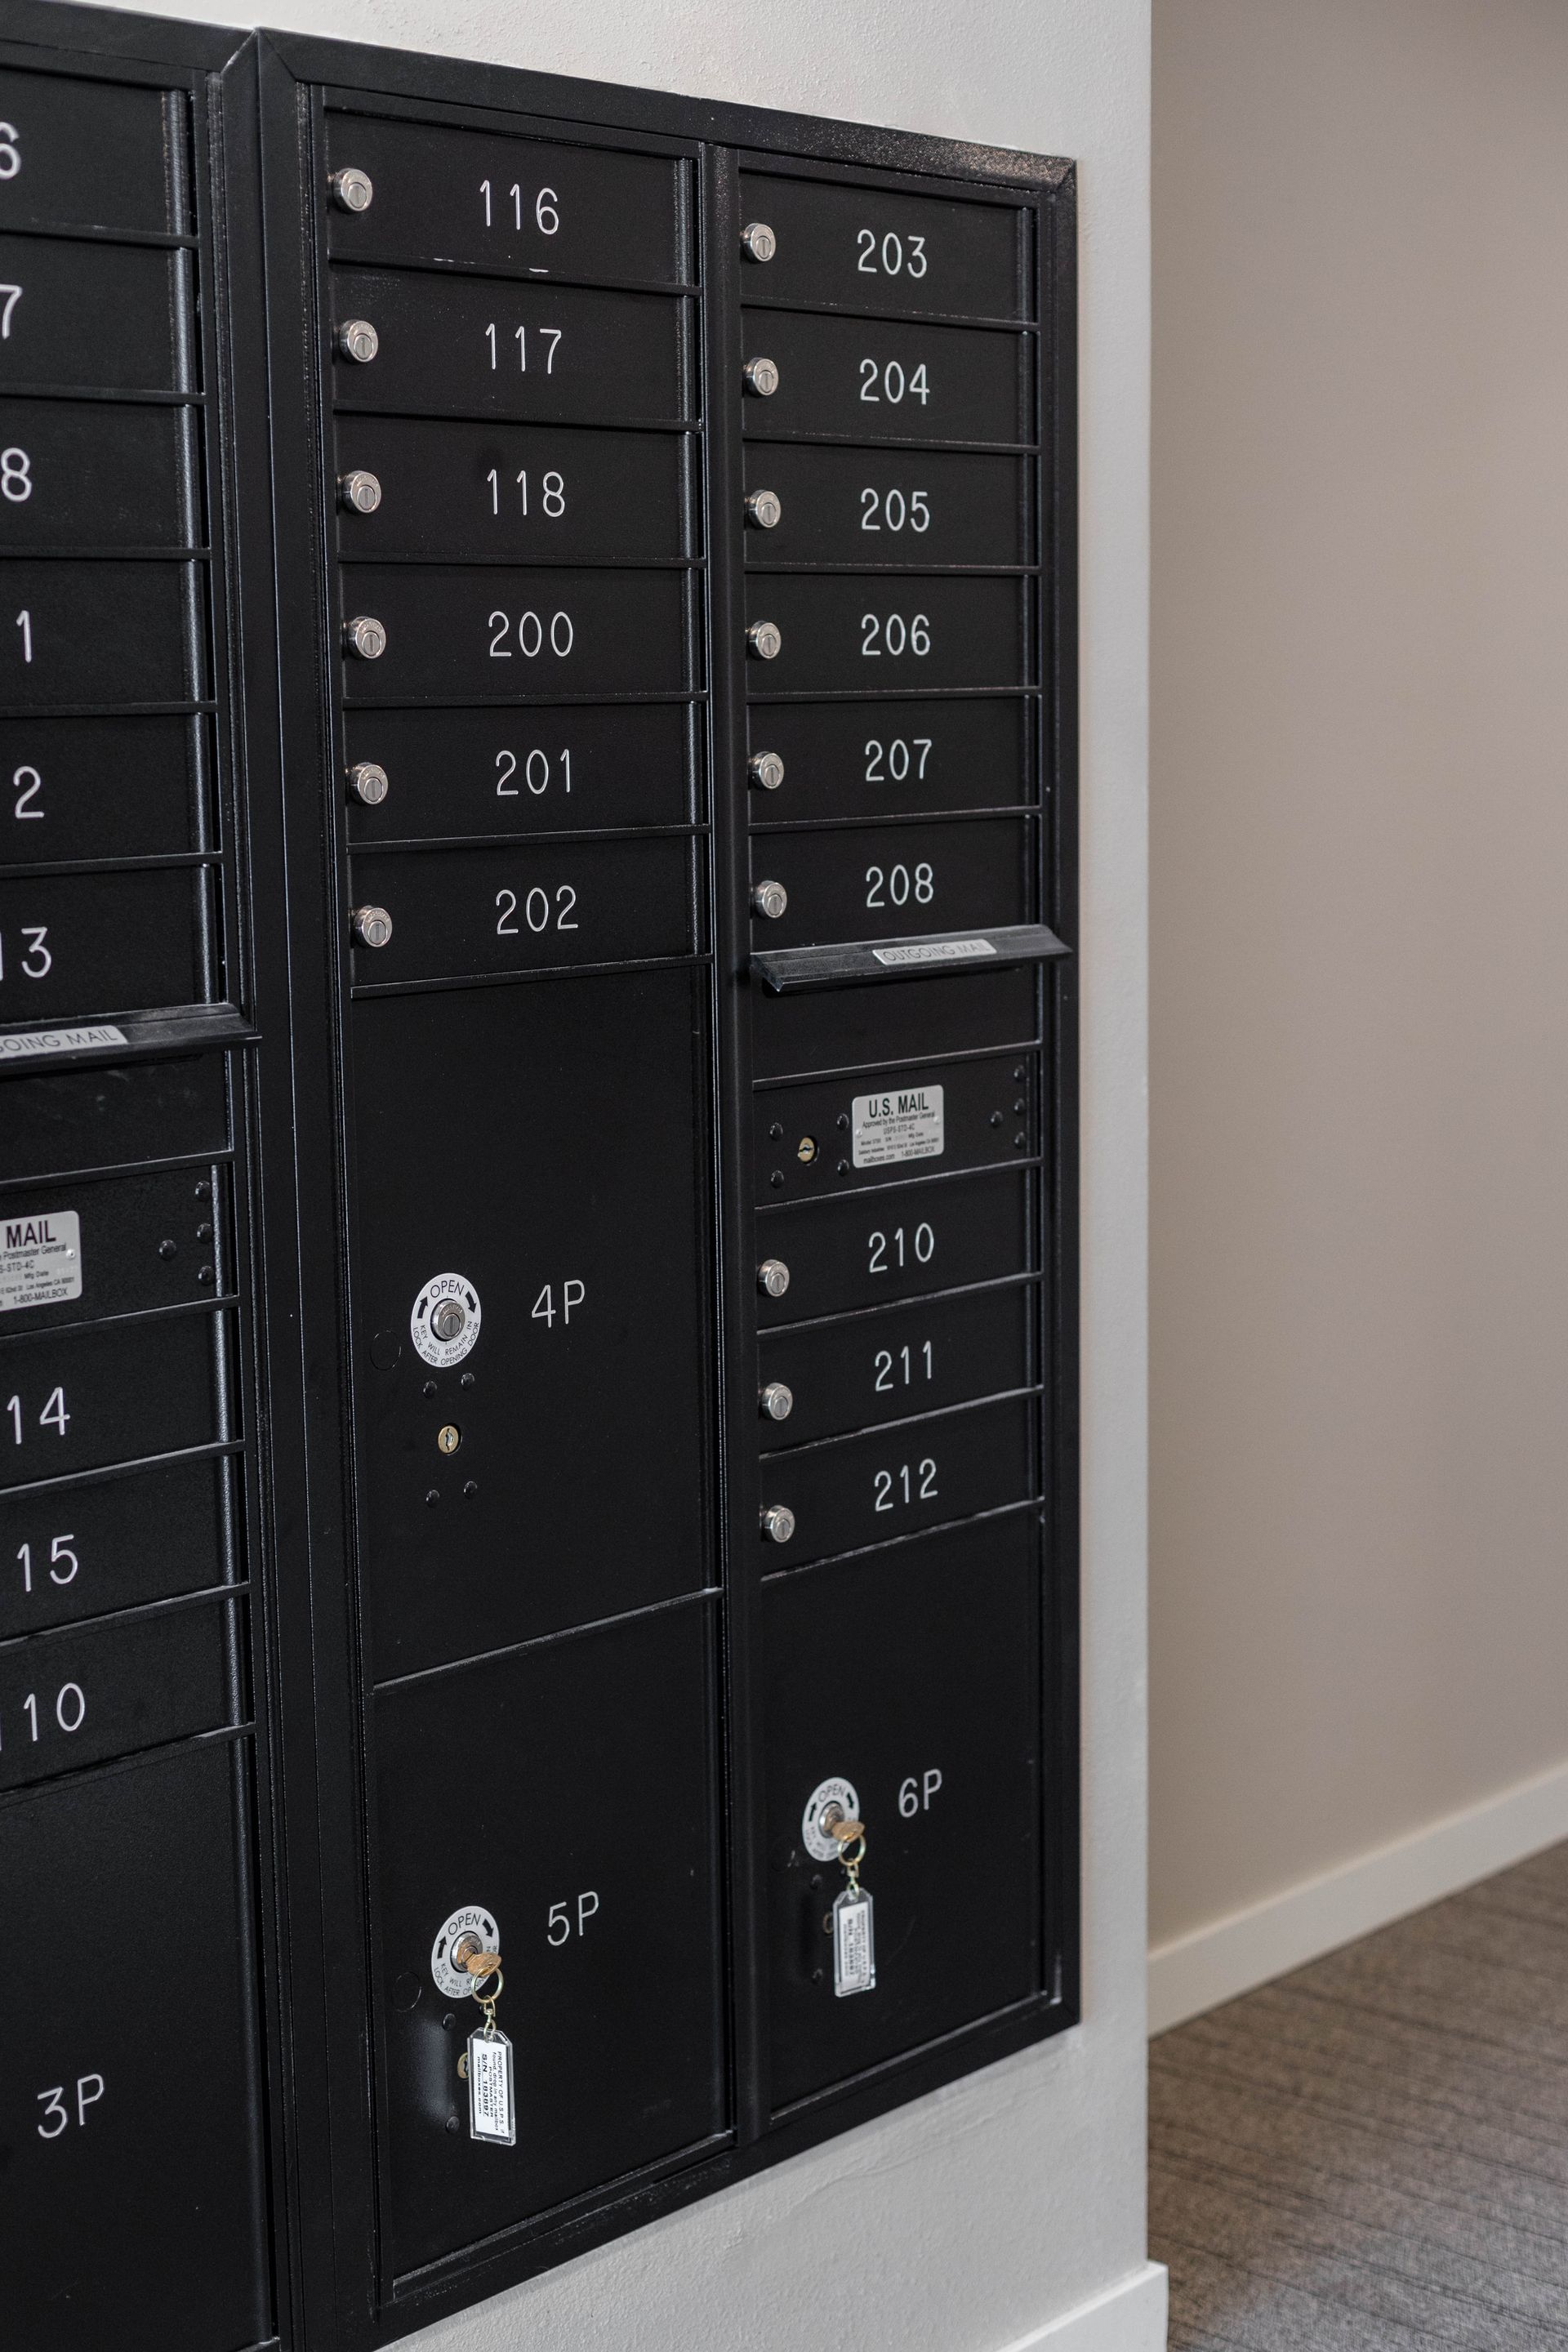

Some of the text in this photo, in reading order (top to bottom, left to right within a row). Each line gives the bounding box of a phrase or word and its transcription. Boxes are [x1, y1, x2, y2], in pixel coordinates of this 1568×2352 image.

[479, 179, 559, 235] 116
[857, 229, 928, 278] 203
[484, 323, 562, 375] 117
[859, 358, 931, 406] 204
[0, 447, 33, 502] 8
[487, 468, 566, 518] 118
[860, 488, 930, 533] 205
[16, 609, 33, 663] 1
[488, 610, 574, 657] 200
[861, 613, 931, 657] 206
[495, 748, 571, 796] 201
[864, 738, 933, 782] 207
[12, 765, 45, 819] 2
[865, 862, 934, 908] 208
[495, 884, 579, 935] 202
[883, 942, 991, 961] OUTGOING MAIL
[0, 1030, 118, 1053] OING MAIL
[862, 1118, 884, 1129] Approved
[896, 1113, 919, 1124] Postmaster
[869, 1093, 929, 1118] U.S. MAIL
[3, 1243, 67, 1260] Postmaster General
[6, 1220, 56, 1249] MAIL
[868, 1222, 935, 1273] 210
[13, 1287, 69, 1304] 1-800-MAILBOX
[430, 1280, 465, 1298] OPEN
[531, 1279, 586, 1329] 4P
[412, 1322, 479, 1365] LOCK AFTER OPENING DOOR
[428, 1342, 440, 1356] WILL
[445, 1335, 468, 1356] REMAIN
[467, 1321, 473, 1330] IN
[875, 1340, 932, 1392] 211
[7, 1386, 71, 1445] 14
[874, 1458, 938, 1512] 212
[16, 1534, 78, 1592] 15
[818, 1784, 846, 1802] OPEN
[898, 1768, 942, 1818] 6P
[448, 1913, 481, 1936] OPEN
[547, 1891, 599, 1946] 5P
[434, 1967, 444, 1987] LOCK
[443, 1984, 460, 1996] AFTER
[441, 1962, 449, 1976] KEY
[449, 1977, 461, 1987] WILL
[37, 2074, 105, 2139] 3P
[498, 2089, 504, 2099] OF
